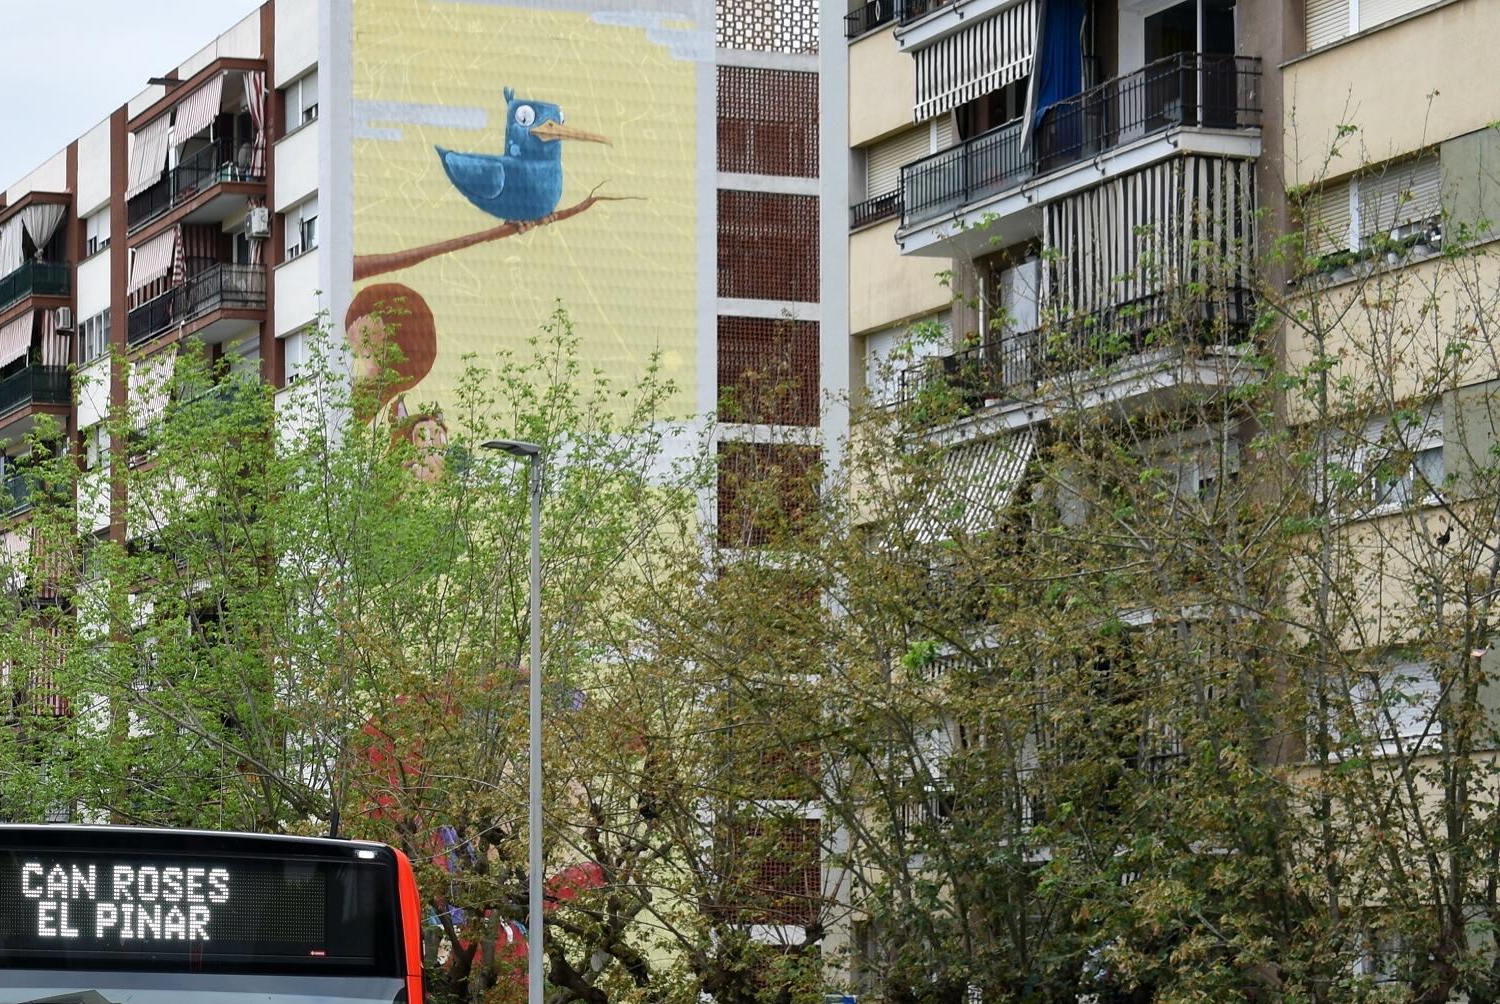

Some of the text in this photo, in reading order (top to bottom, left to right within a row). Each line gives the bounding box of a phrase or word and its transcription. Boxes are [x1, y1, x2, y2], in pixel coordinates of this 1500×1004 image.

[22, 863, 97, 899] CAN
[114, 865, 230, 903] ROSES
[38, 901, 210, 940] EL PINAR
